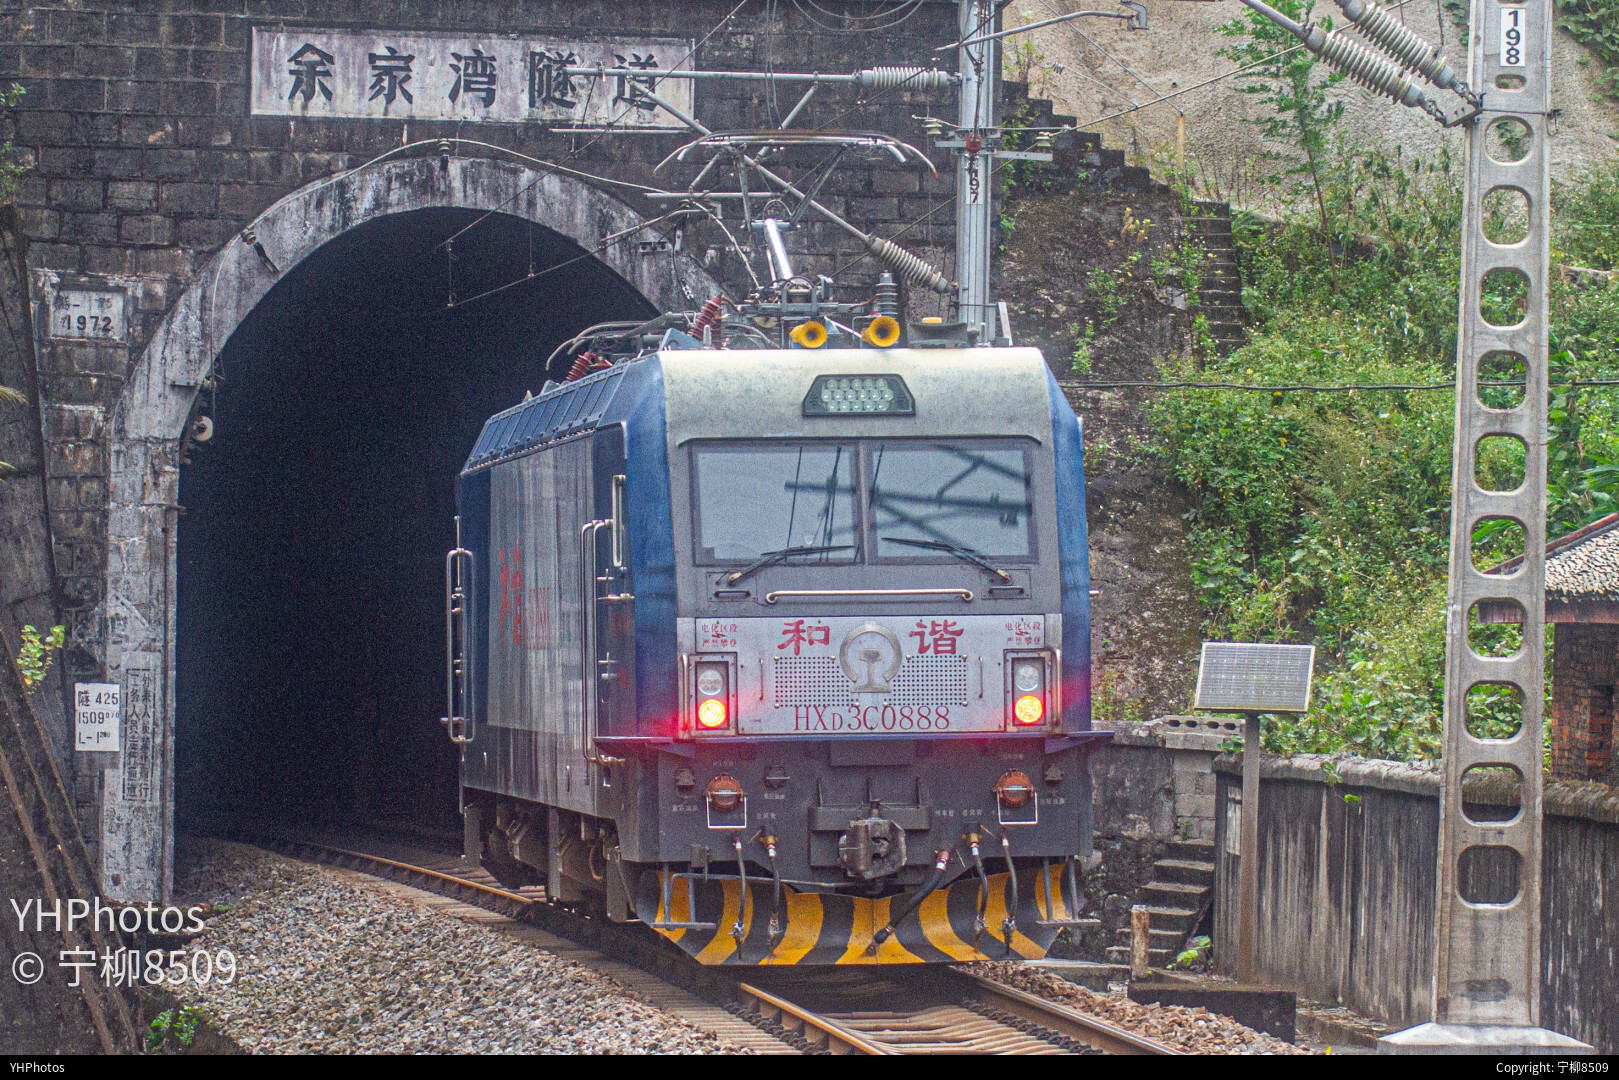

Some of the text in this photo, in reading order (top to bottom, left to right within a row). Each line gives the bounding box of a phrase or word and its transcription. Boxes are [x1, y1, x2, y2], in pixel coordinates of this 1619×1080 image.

[1505, 10, 1521, 65] 198
[286, 42, 660, 112] 余家湾隧道
[65, 315, 113, 332] 1972
[95, 692, 119, 705] 425
